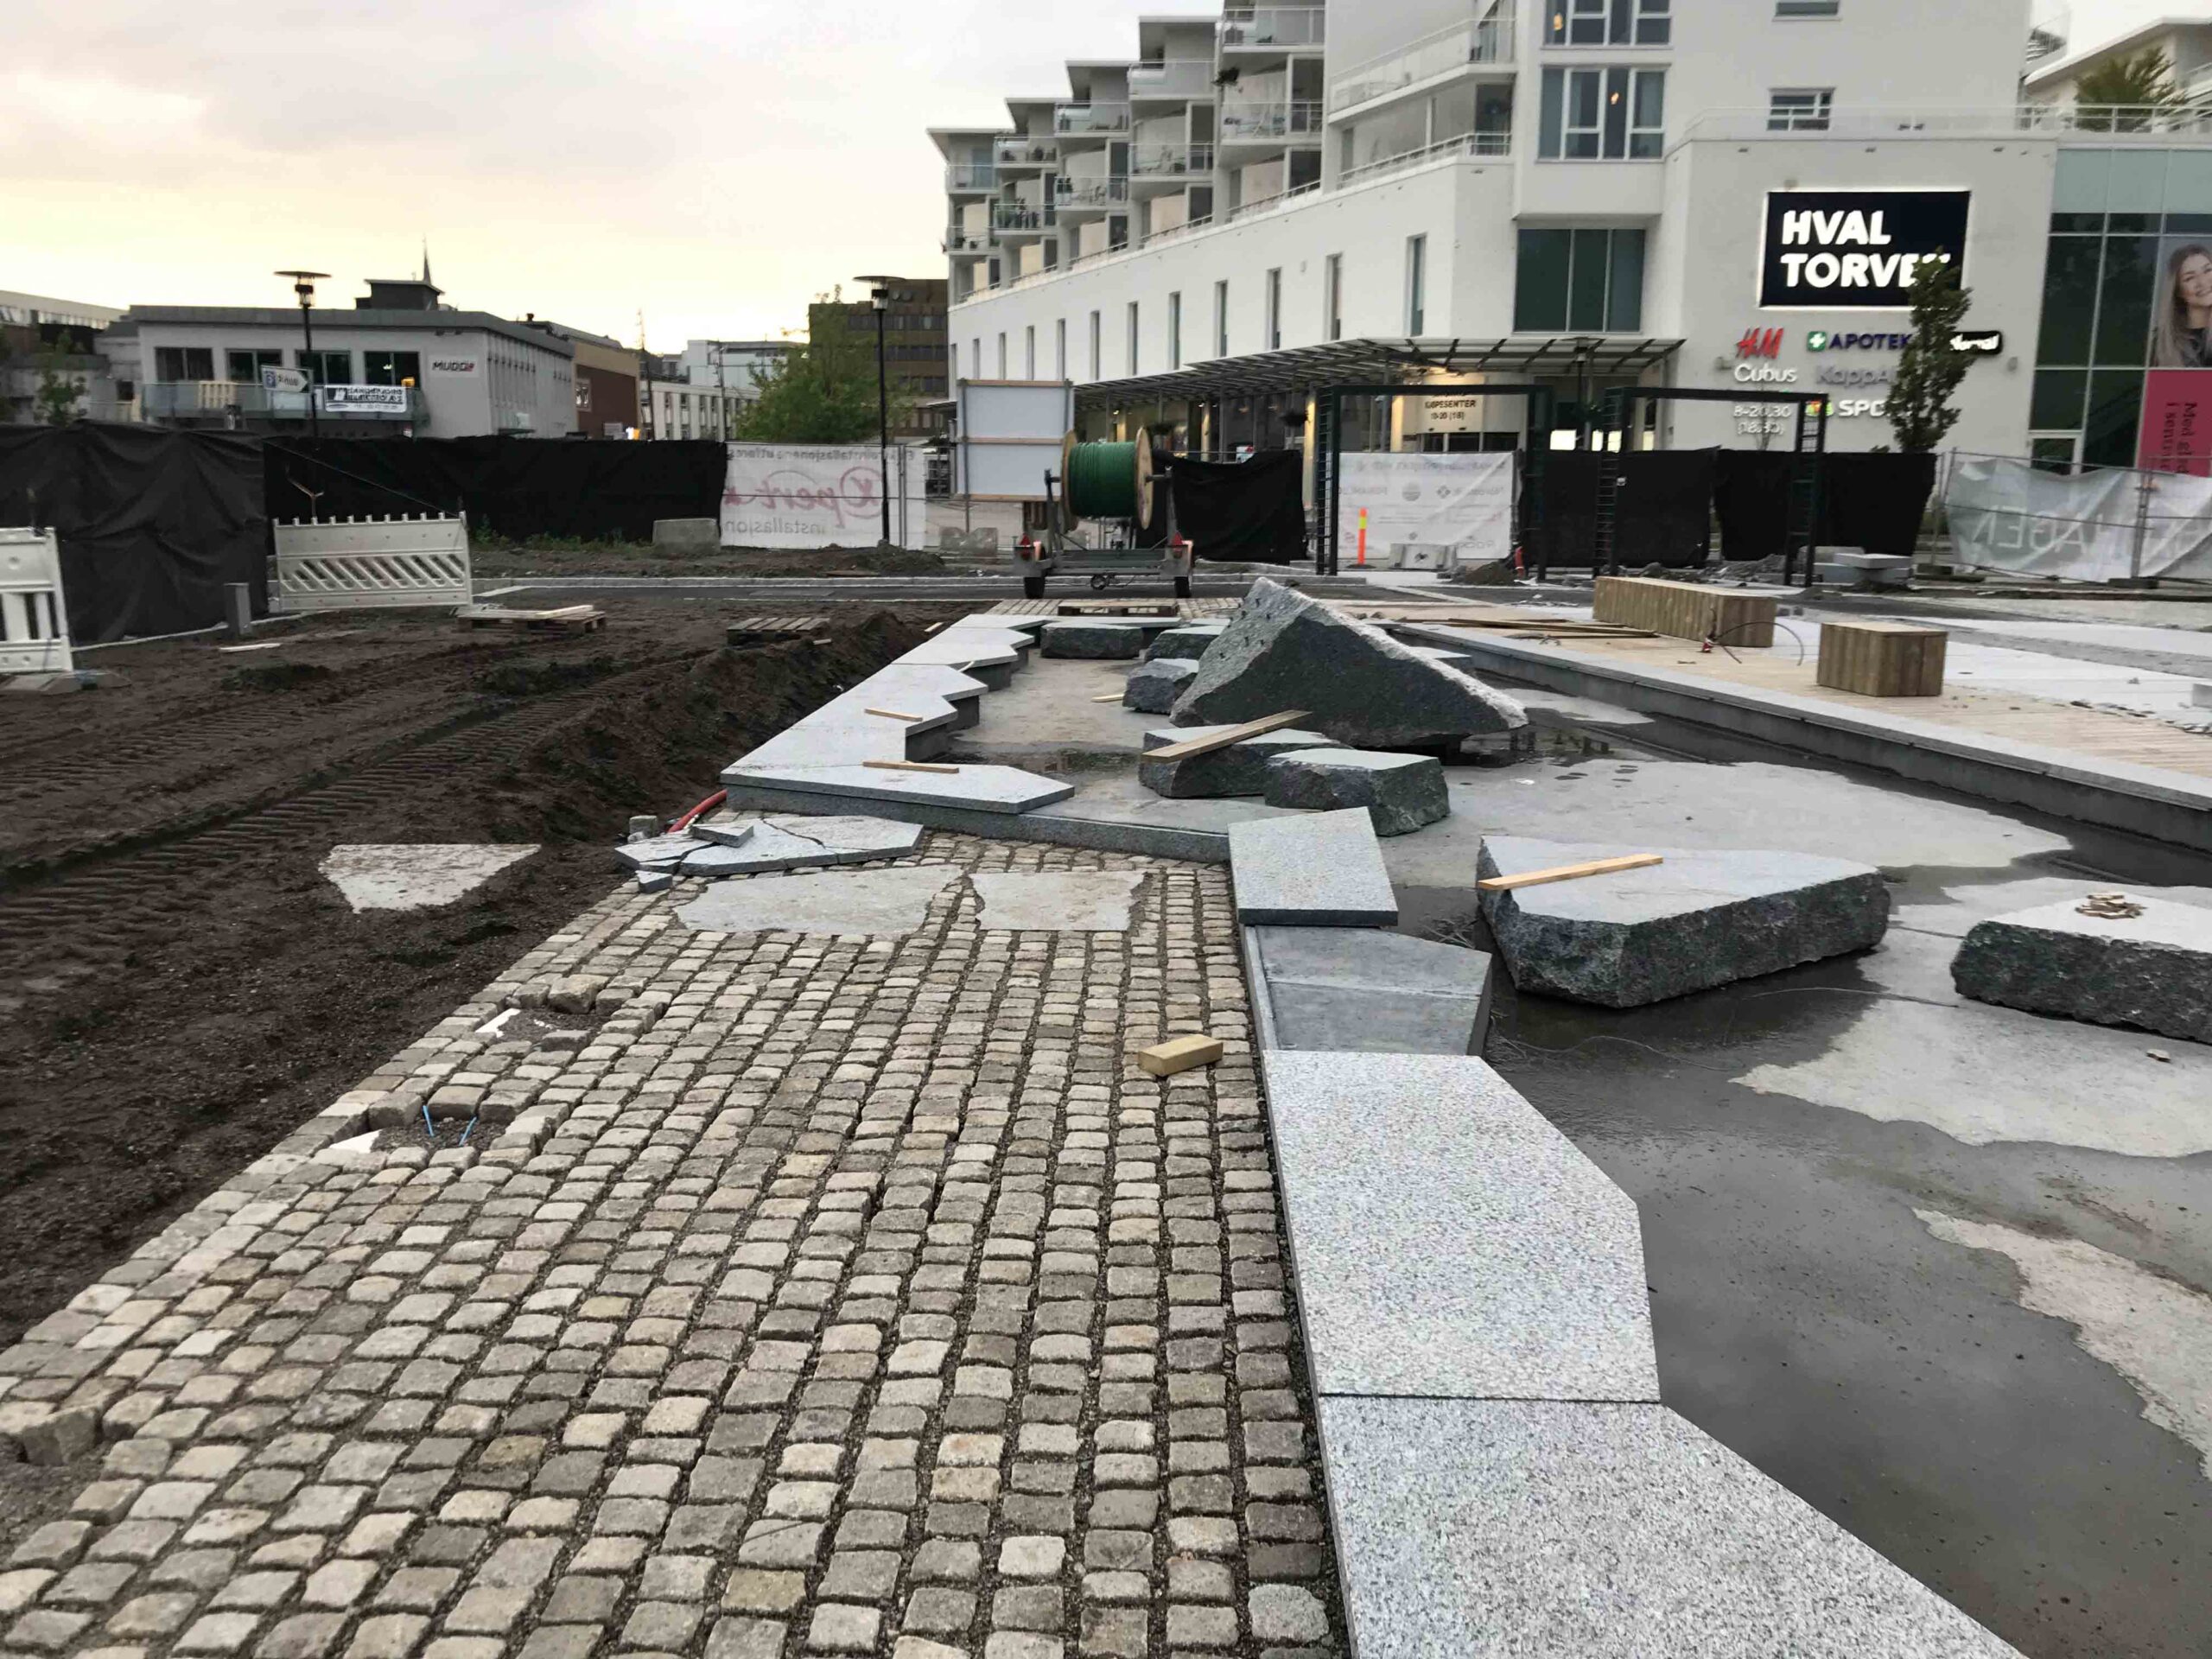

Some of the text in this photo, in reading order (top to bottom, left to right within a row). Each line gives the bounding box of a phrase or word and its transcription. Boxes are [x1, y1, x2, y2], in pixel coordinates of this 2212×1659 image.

[1782, 210, 1891, 245] HVAL
[1828, 334, 1913, 350] APOTEK
[1734, 363, 1797, 383] Cubus
